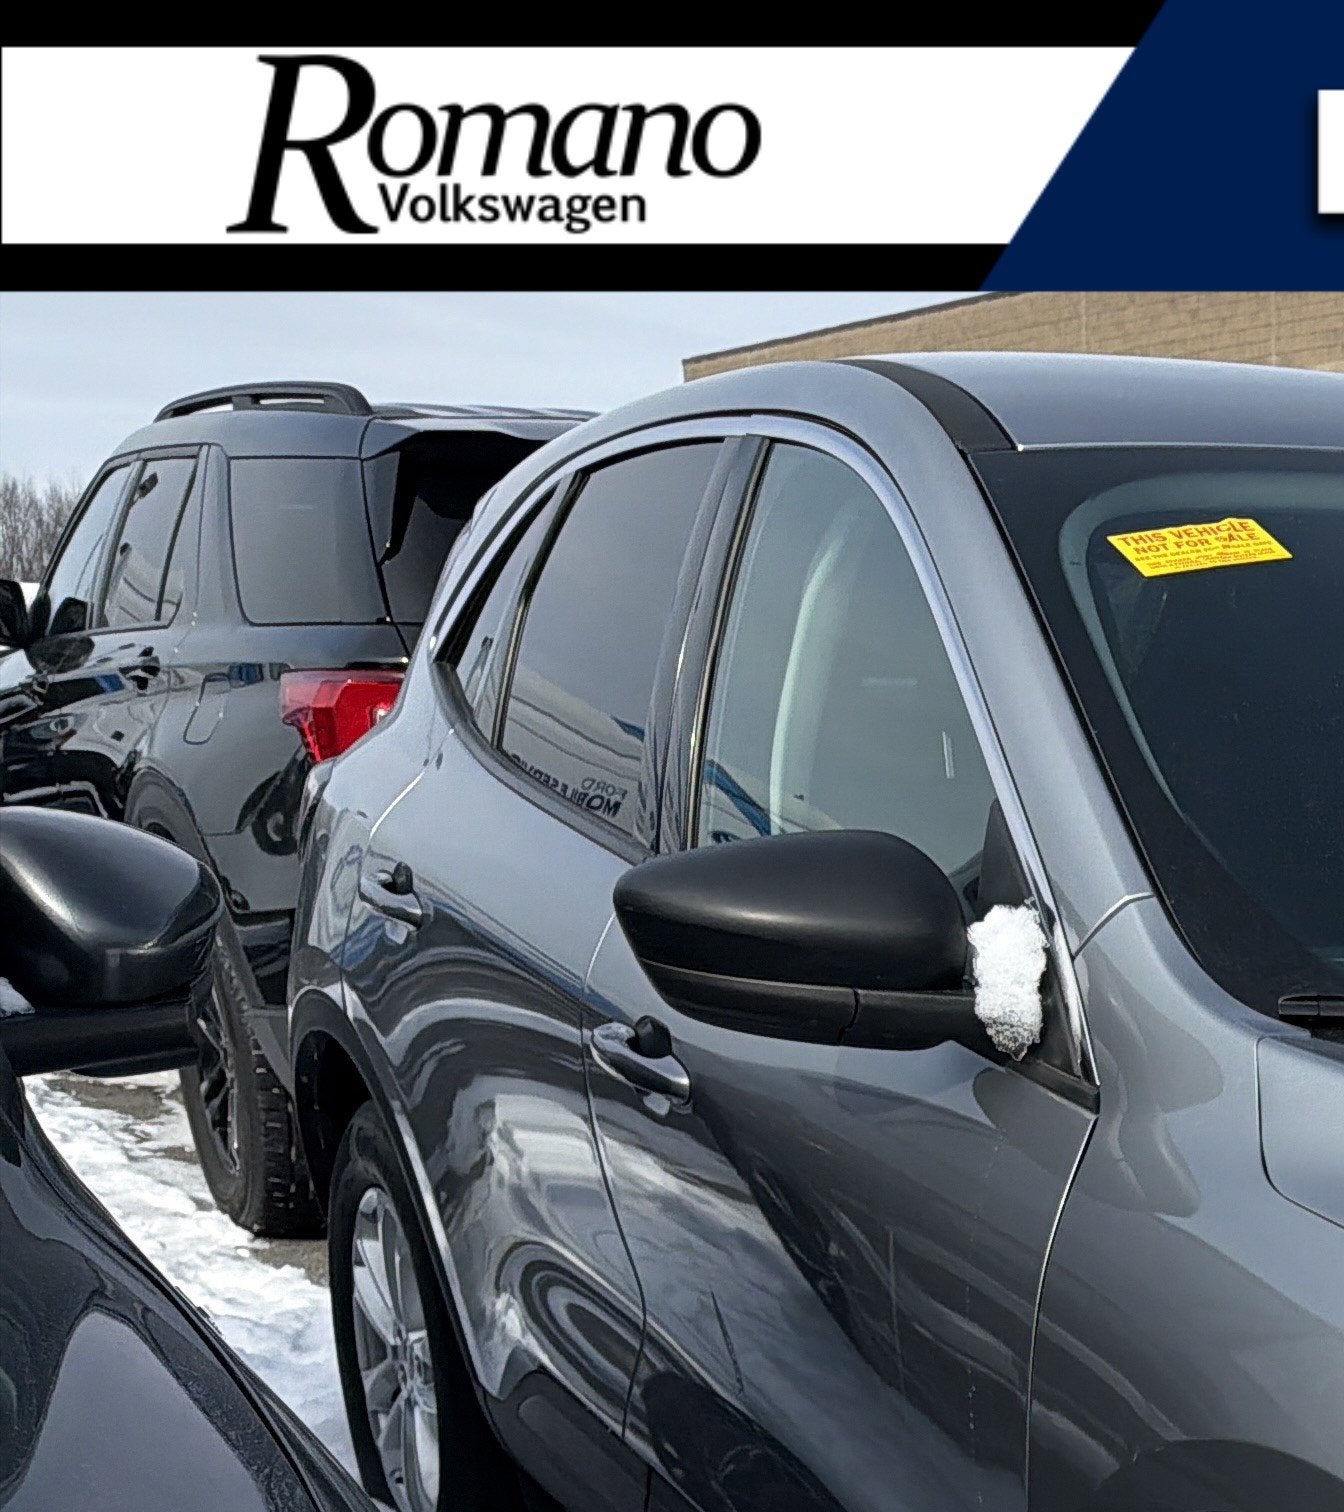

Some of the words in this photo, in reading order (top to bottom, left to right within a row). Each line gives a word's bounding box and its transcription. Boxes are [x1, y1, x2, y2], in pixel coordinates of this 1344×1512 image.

[1117, 532, 1168, 547] THIS
[1169, 520, 1255, 540] VEHICLE
[1133, 544, 1170, 555] NOT
[1172, 539, 1210, 549] FOR
[1214, 532, 1260, 543] SALE
